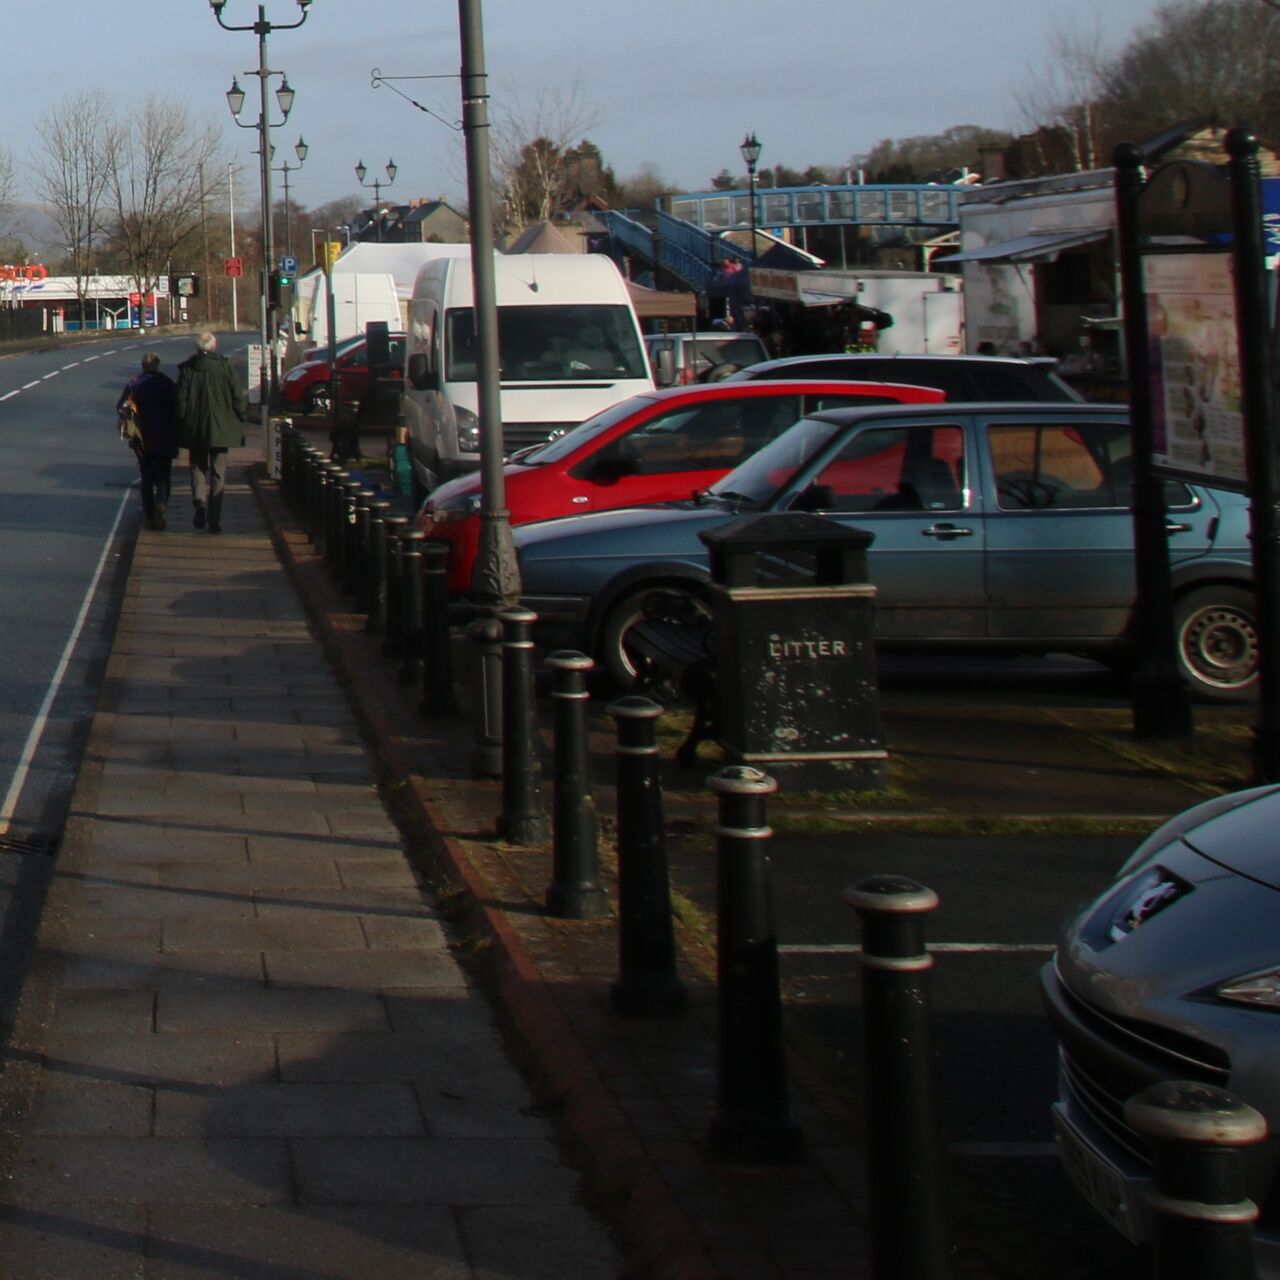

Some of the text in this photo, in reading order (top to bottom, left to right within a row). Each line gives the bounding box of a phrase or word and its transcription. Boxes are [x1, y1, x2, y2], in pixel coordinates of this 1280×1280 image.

[284, 258, 295, 271] P
[274, 423, 282, 476] OPEN
[769, 640, 845, 658] LITTER
